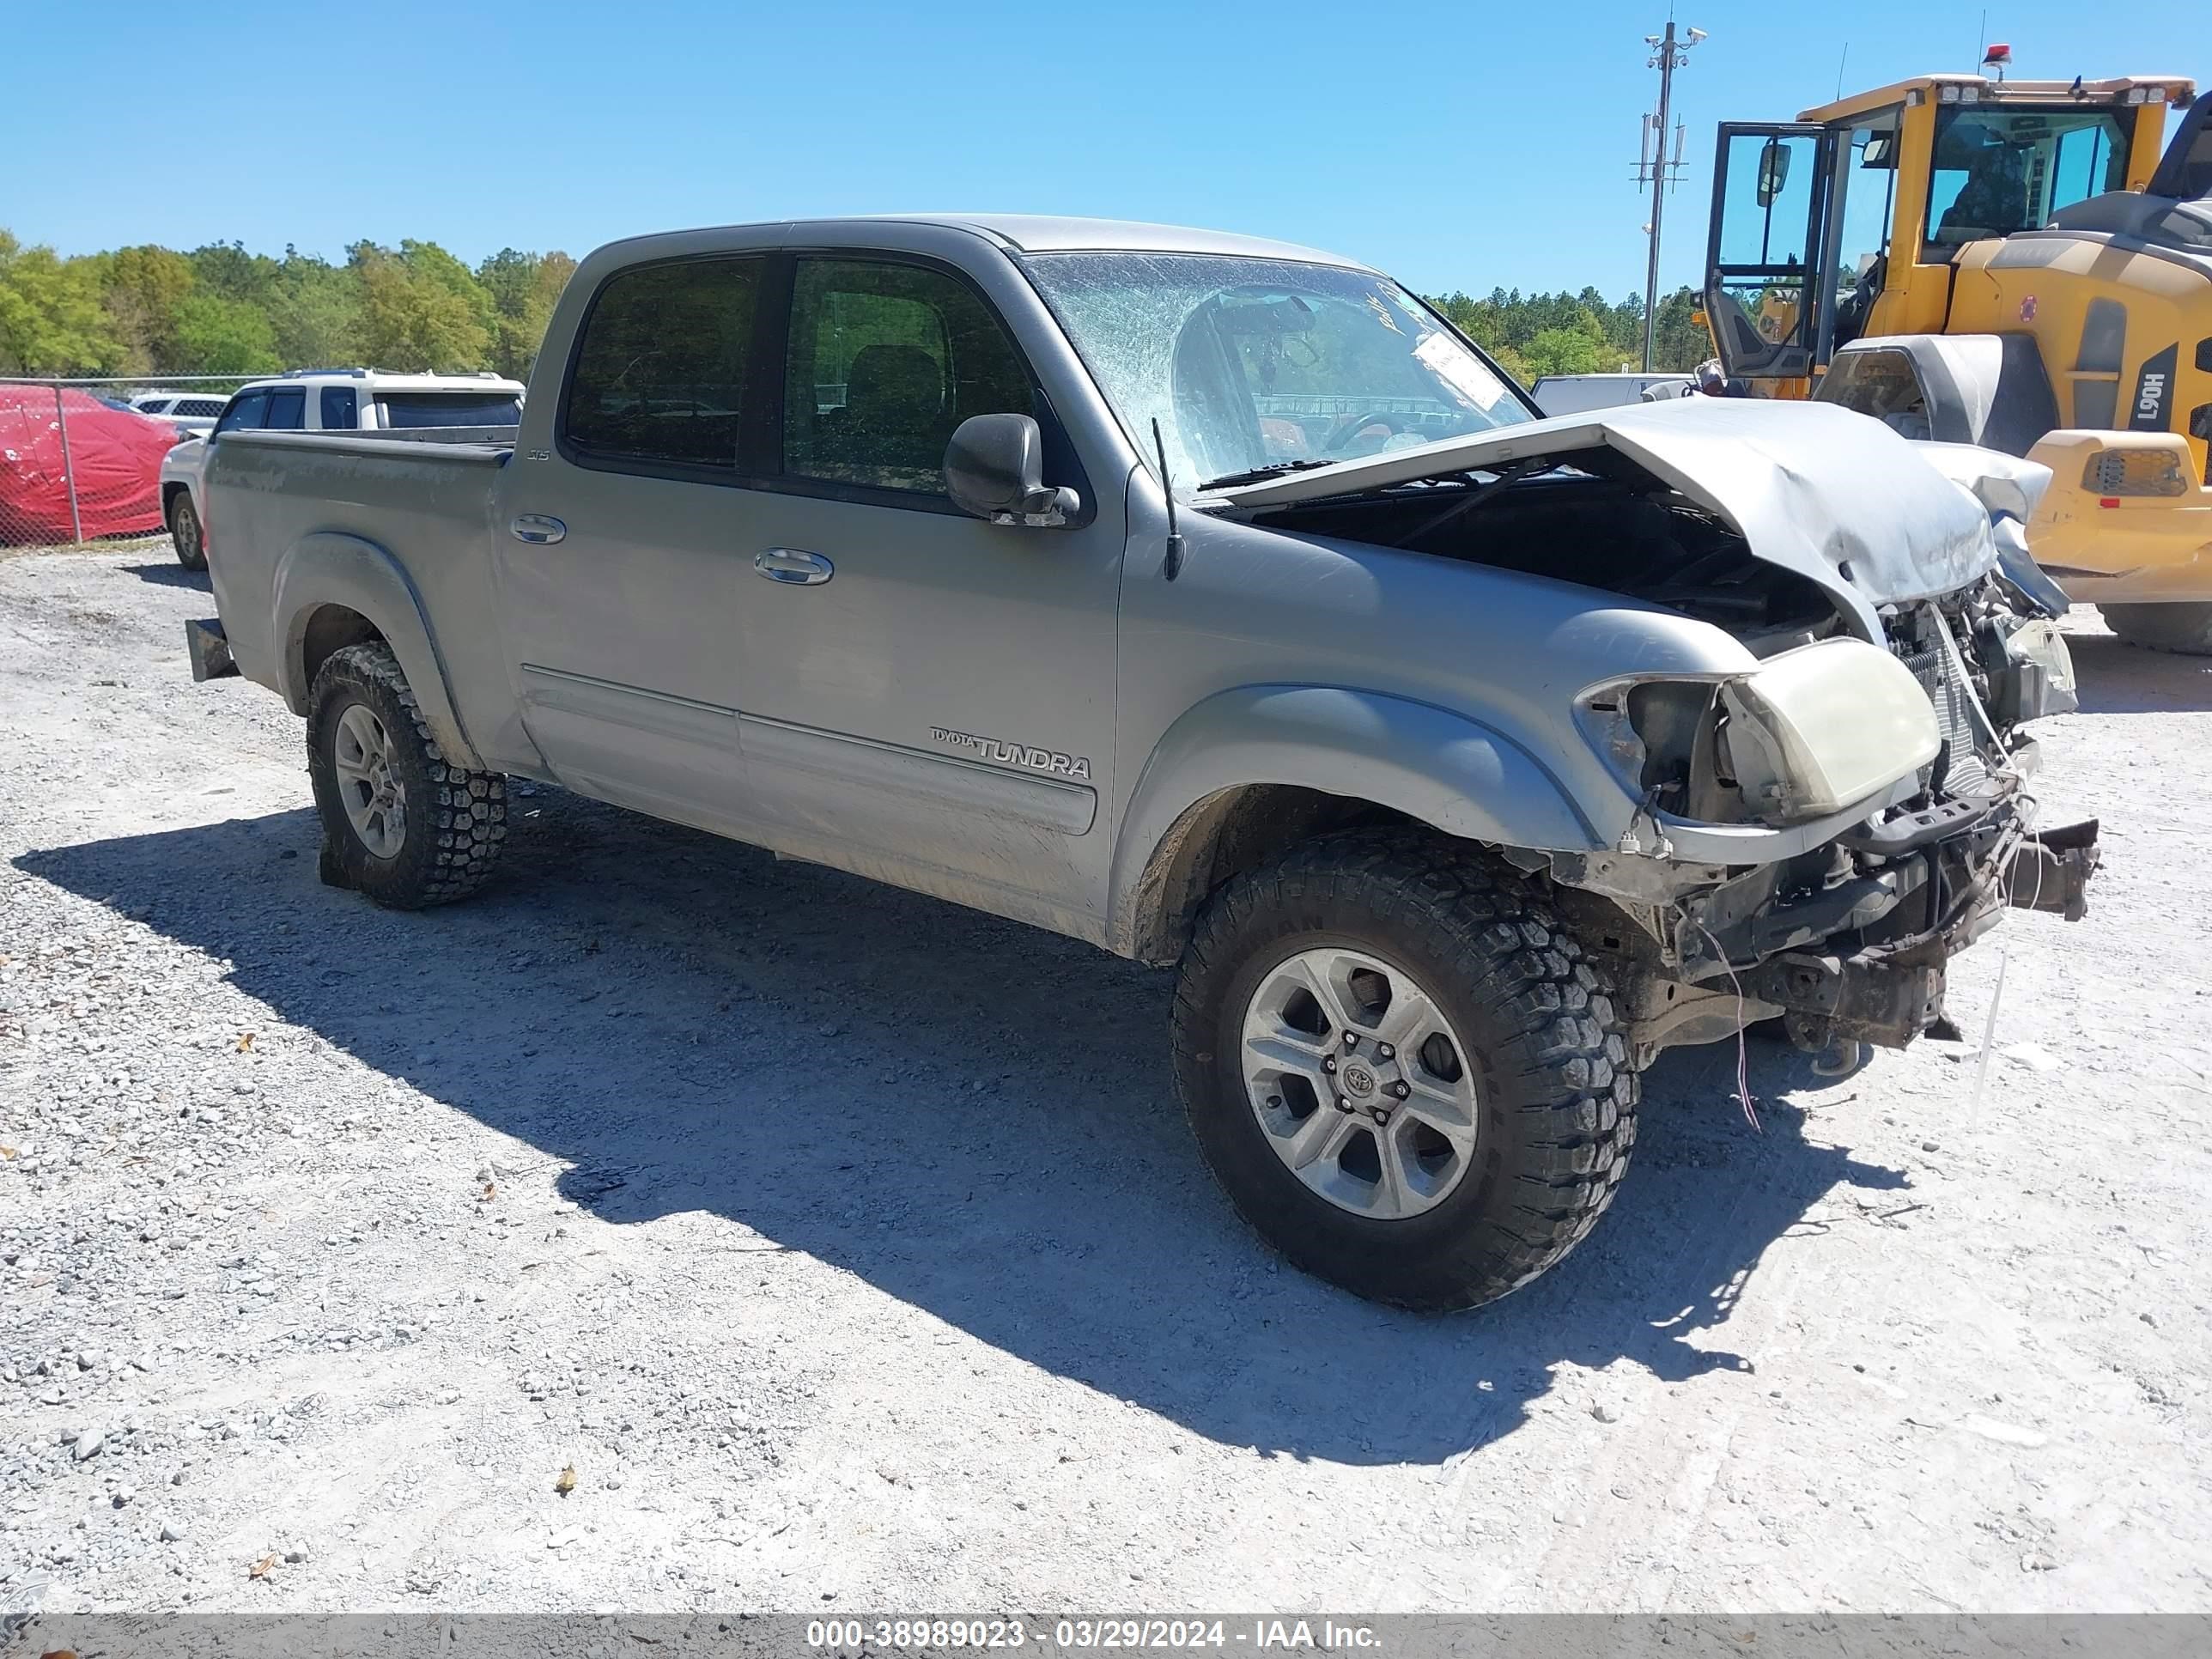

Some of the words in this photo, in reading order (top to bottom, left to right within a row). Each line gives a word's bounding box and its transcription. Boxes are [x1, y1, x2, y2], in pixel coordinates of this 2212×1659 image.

[2137, 374, 2166, 420] L90H
[929, 726, 976, 748] TOYOTA
[975, 737, 1091, 780] TUNDRA
